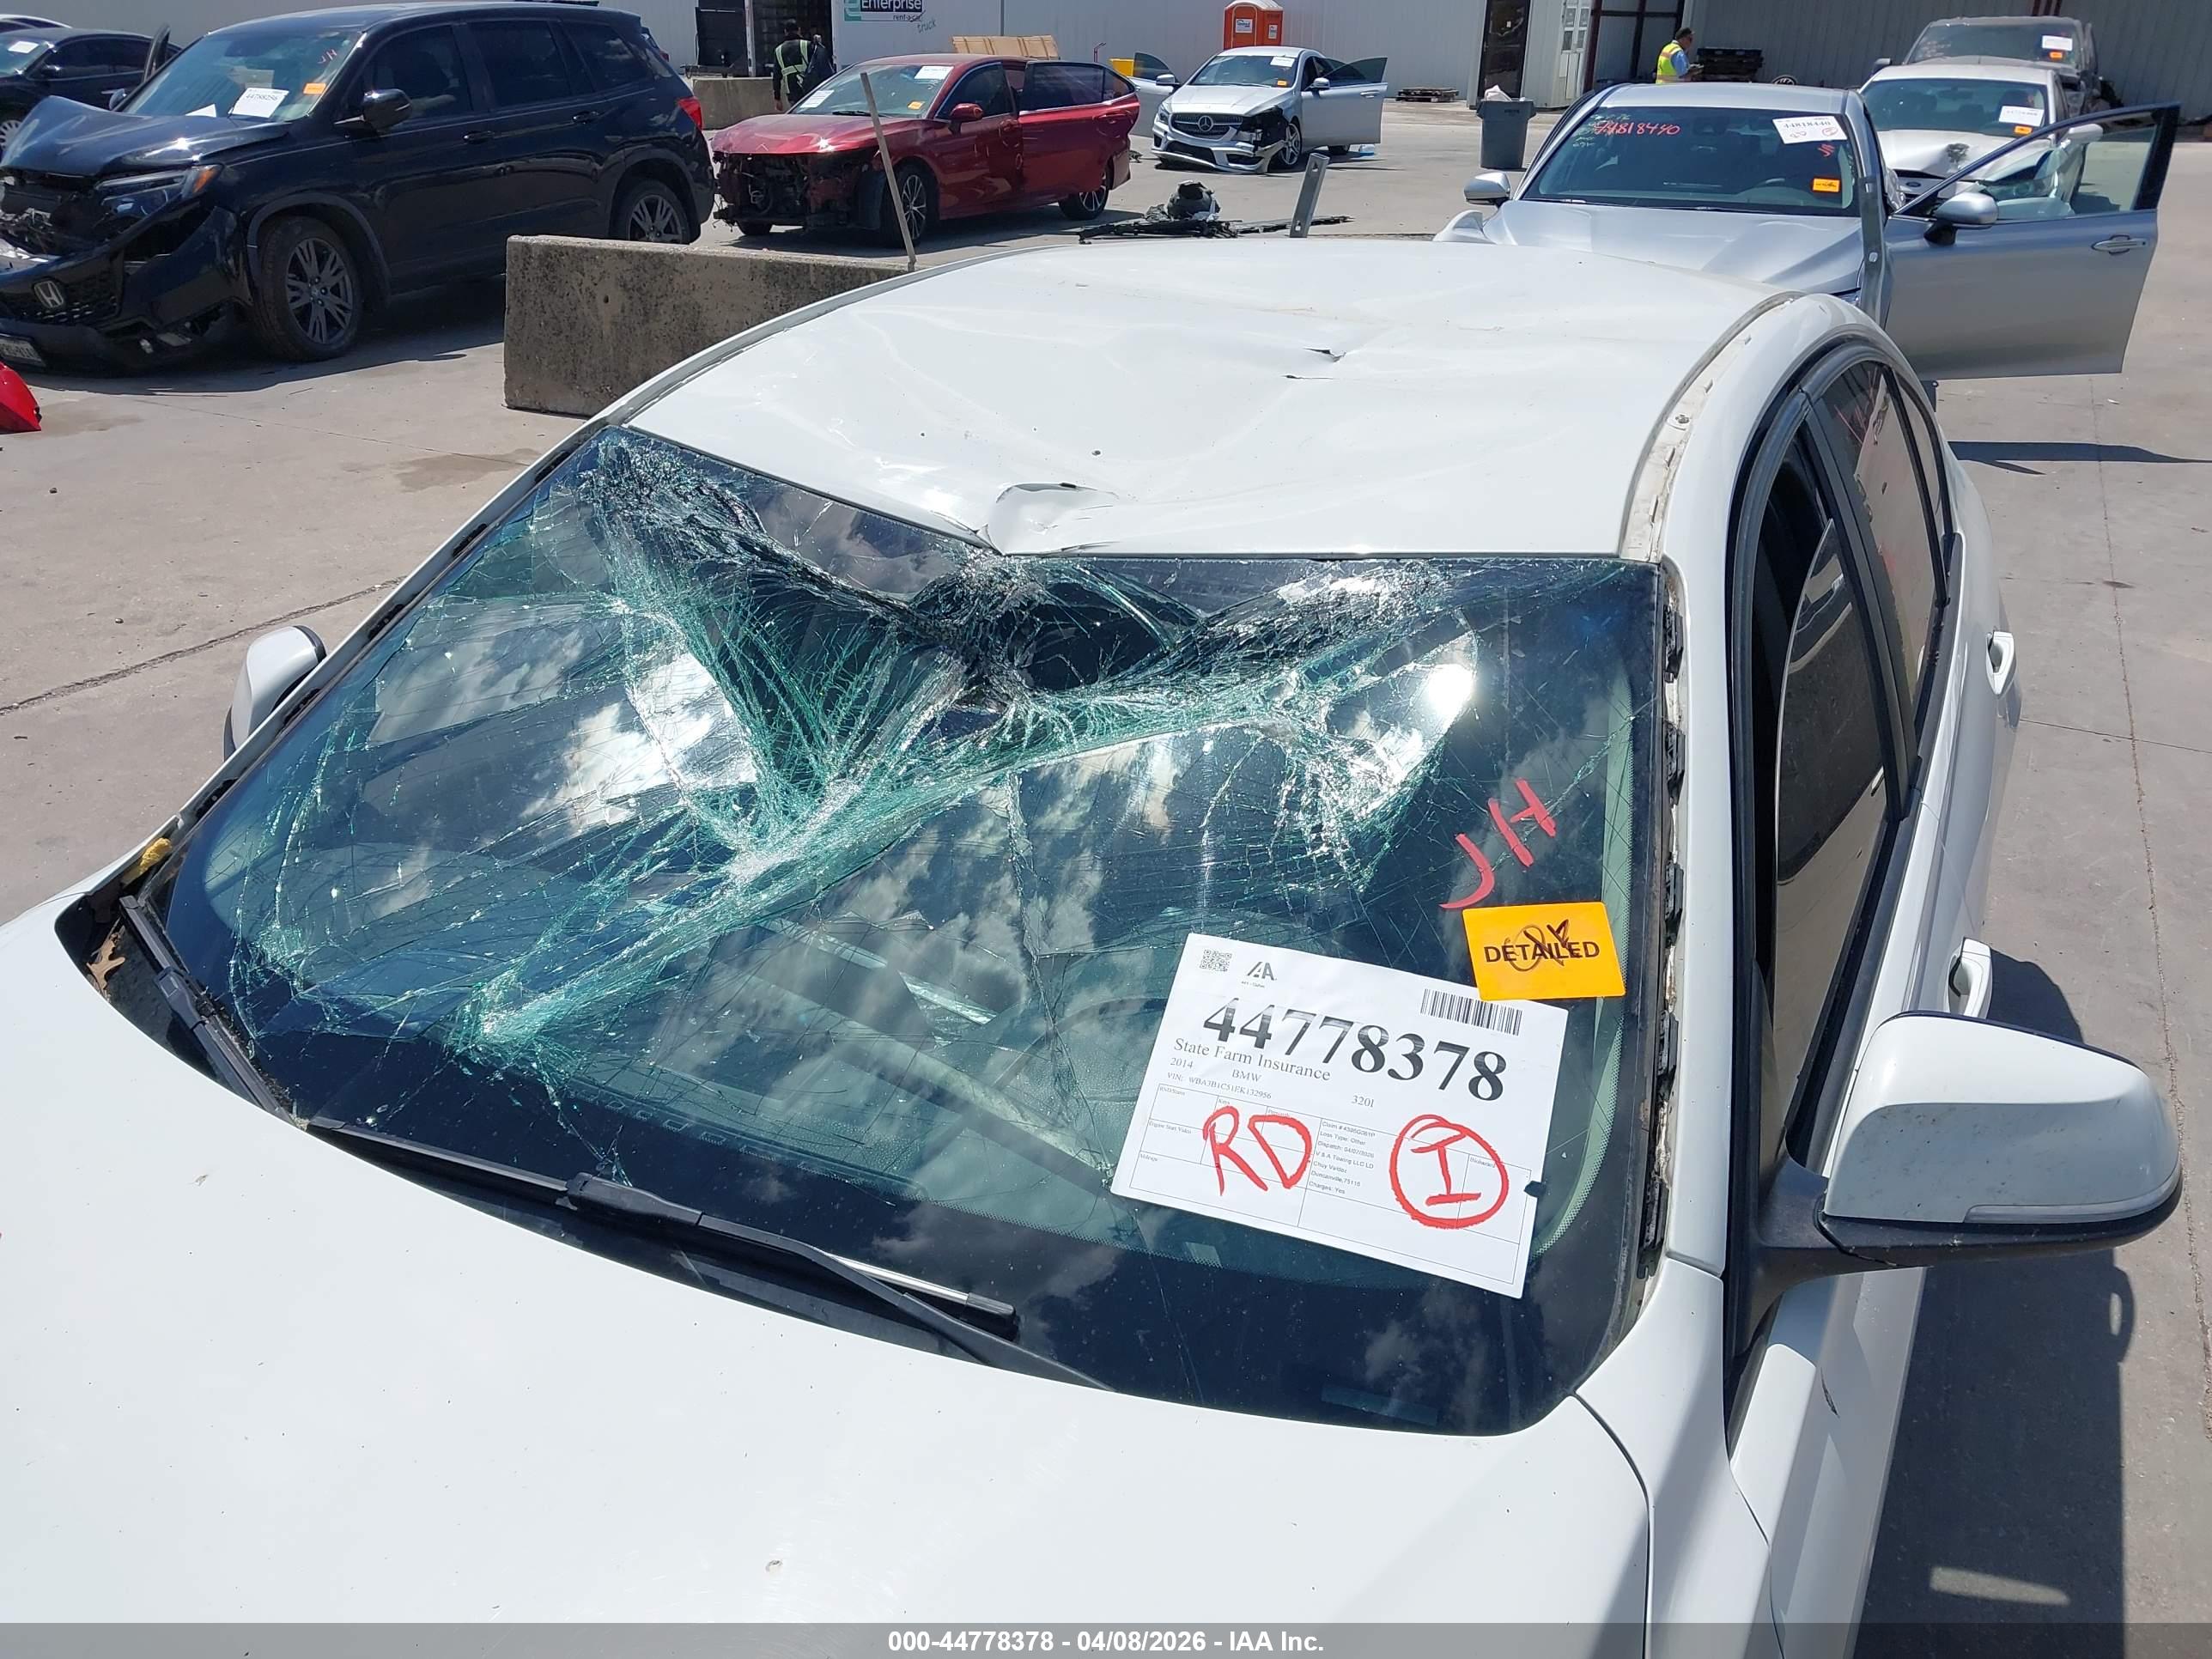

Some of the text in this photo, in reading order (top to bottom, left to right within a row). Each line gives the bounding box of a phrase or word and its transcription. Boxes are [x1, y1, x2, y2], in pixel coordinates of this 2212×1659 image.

[1484, 941, 1600, 963] DETAILED
[1174, 1037, 1331, 1081] State Farm Insurance
[1203, 997, 1506, 1101] 44778378
[1168, 1072, 1183, 1082] VIN:
[1170, 1057, 1194, 1070] 2014
[1231, 1069, 1262, 1083] BMW
[1202, 1106, 1312, 1196] RD
[1333, 1154, 1352, 1164] Towing
